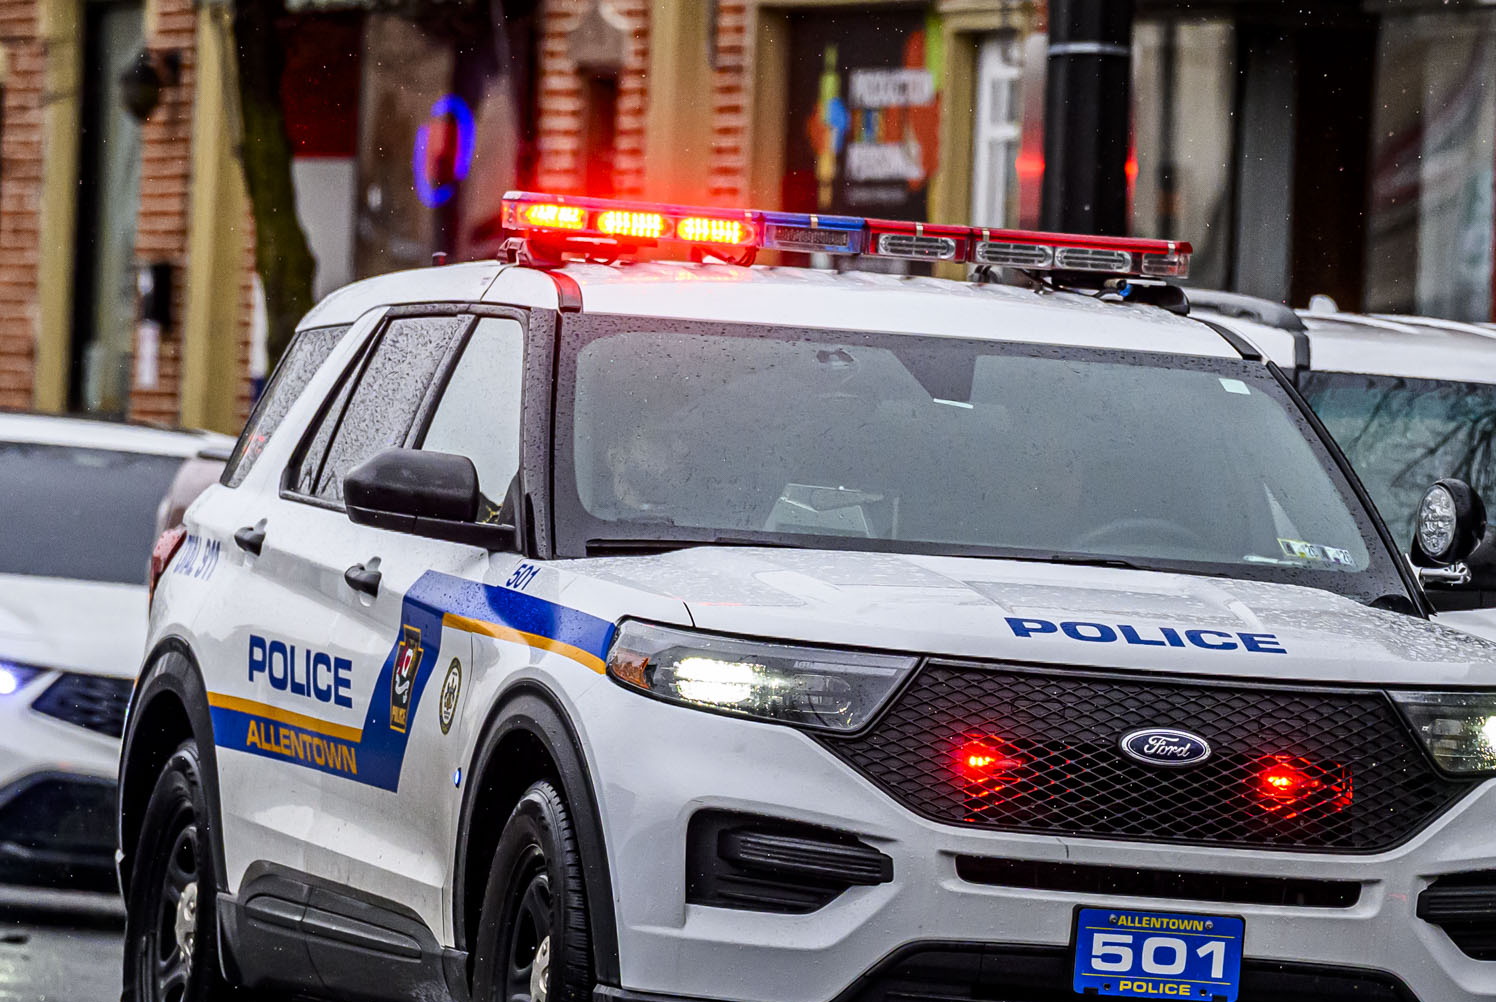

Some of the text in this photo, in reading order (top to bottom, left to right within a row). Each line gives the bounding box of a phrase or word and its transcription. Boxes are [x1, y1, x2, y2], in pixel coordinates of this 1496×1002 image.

[194, 538, 221, 581] 911
[506, 564, 541, 590] 501
[1004, 617, 1287, 654] POLICE
[248, 634, 353, 709] POLICE
[246, 720, 358, 775] ALLENTOWN
[1143, 735, 1191, 757] Ford
[1117, 915, 1204, 931] ALLENTOWN
[1091, 933, 1226, 979] 501
[1119, 980, 1191, 996] POLICE
